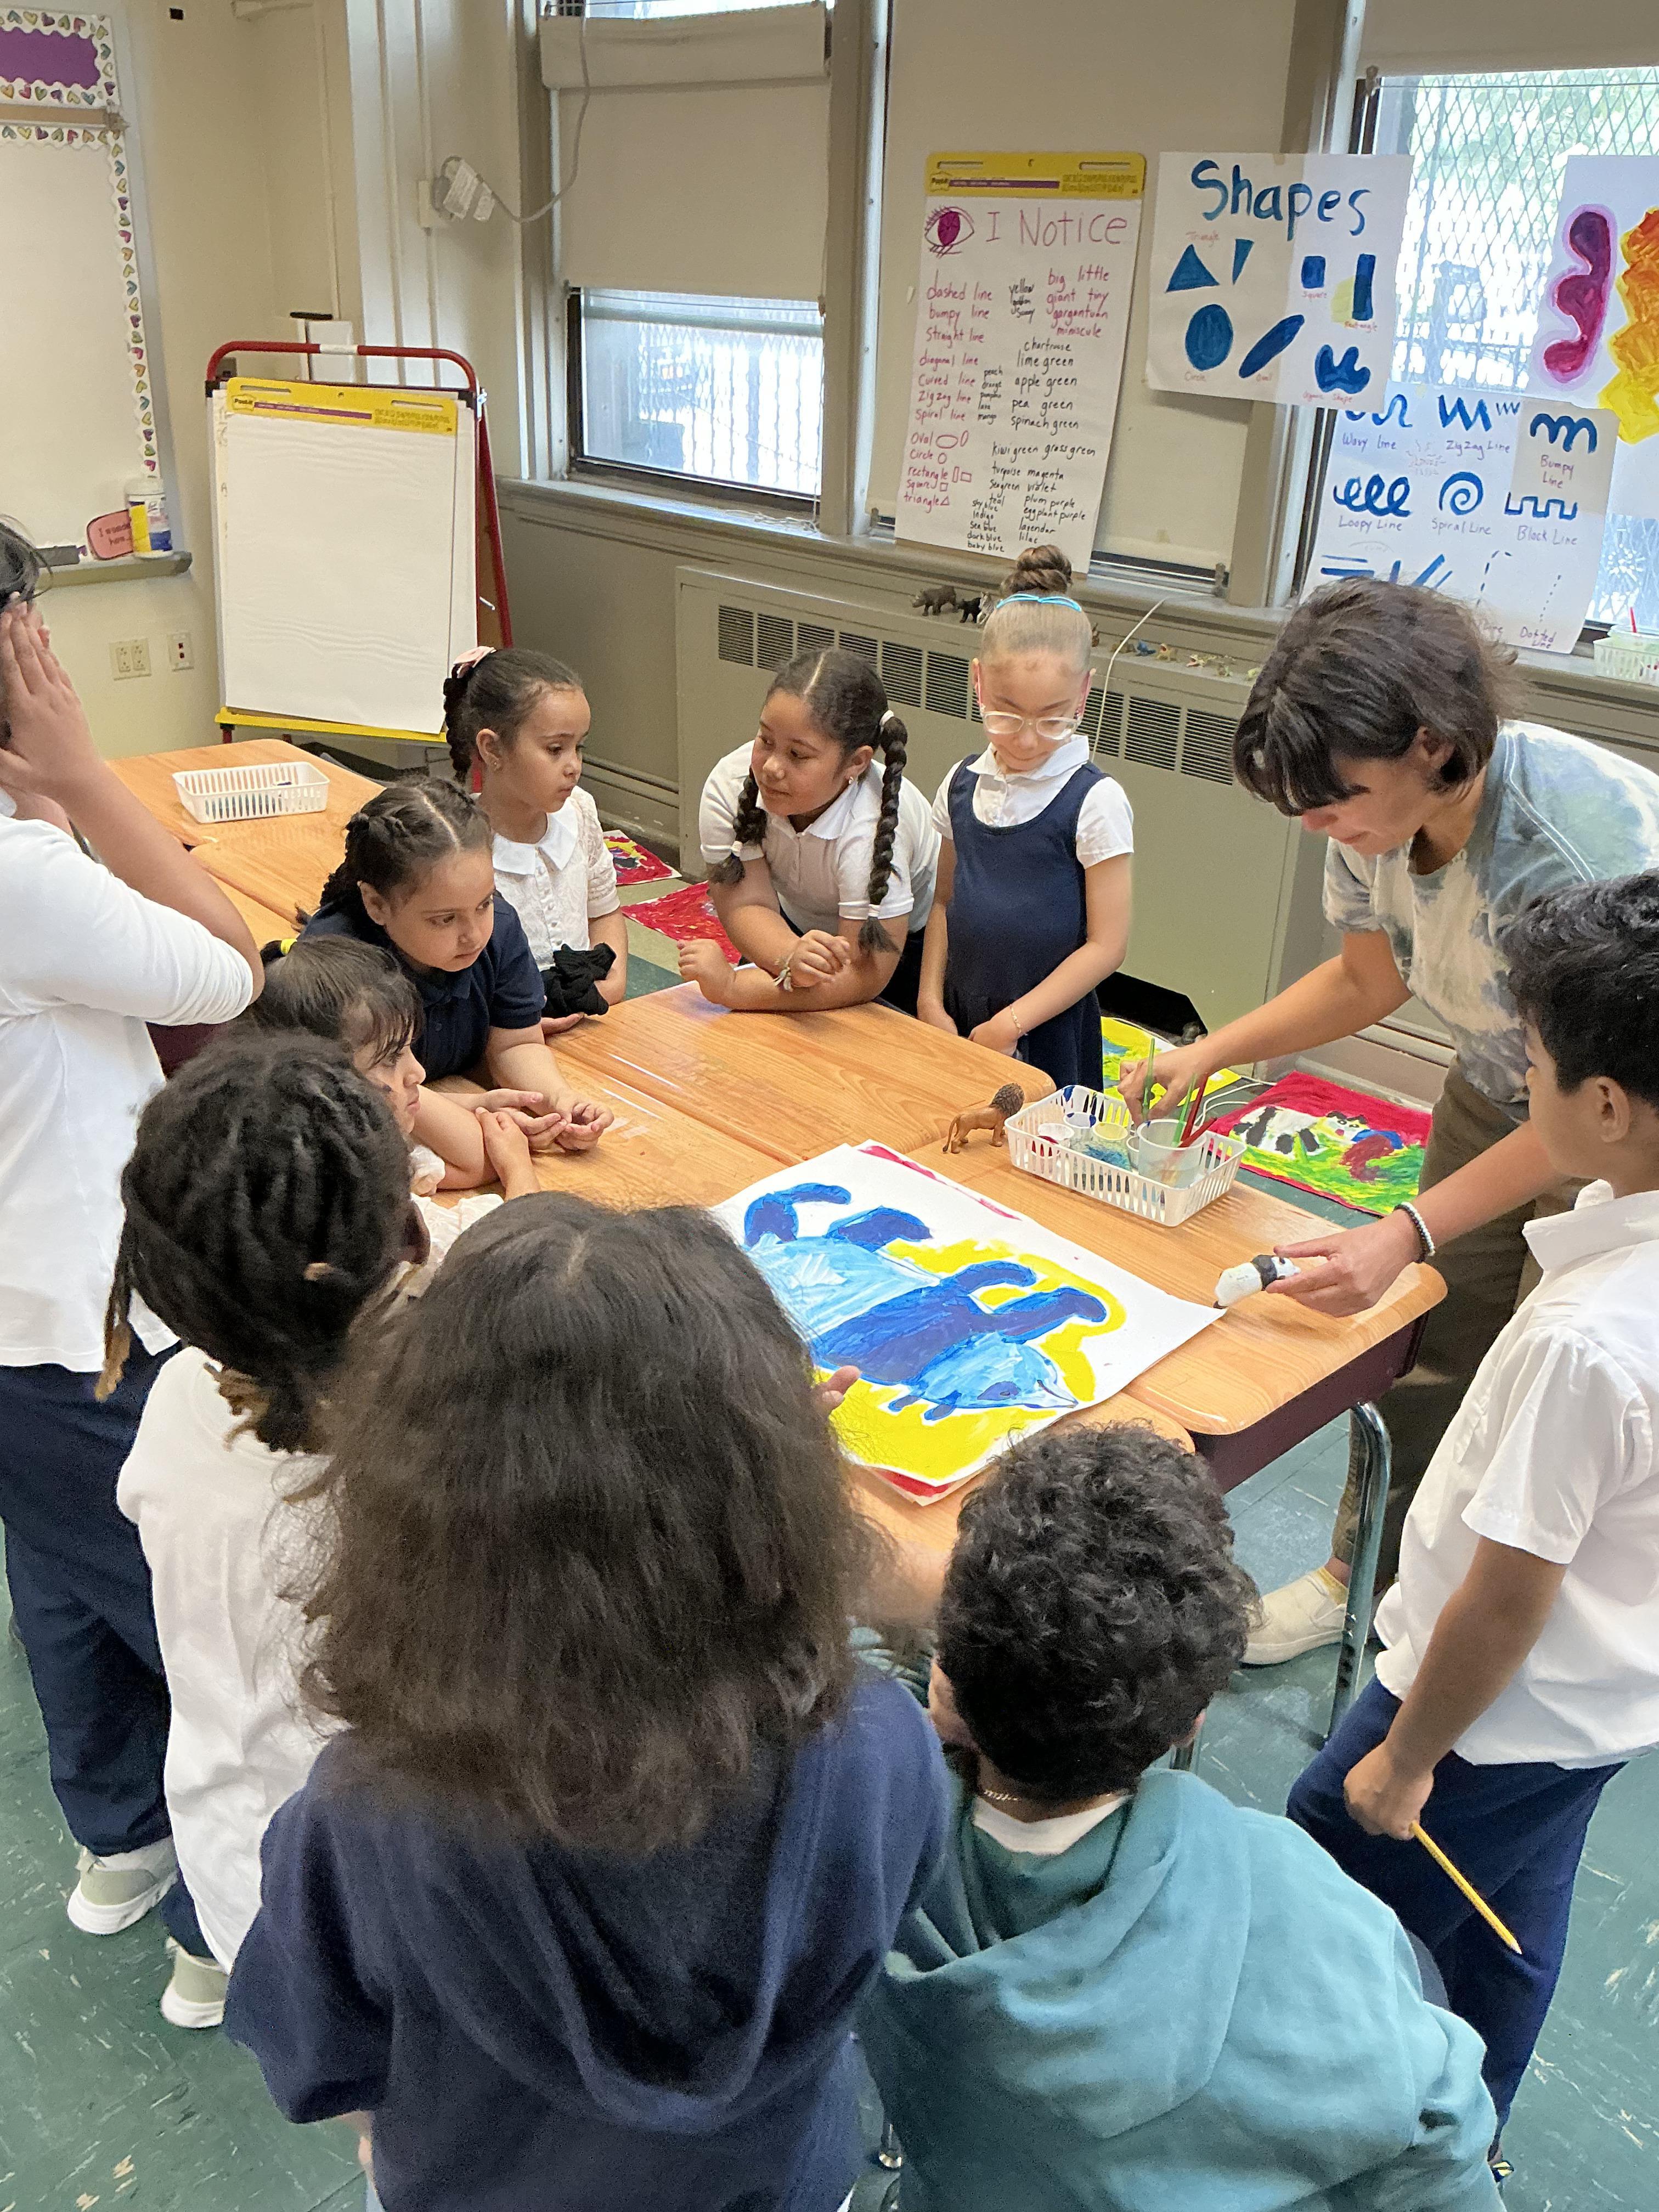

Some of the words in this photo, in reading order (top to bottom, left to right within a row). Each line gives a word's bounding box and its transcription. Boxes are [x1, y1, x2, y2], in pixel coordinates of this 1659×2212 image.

[1190, 159, 1371, 242] Shapes
[986, 211, 1000, 242] I
[1019, 207, 1127, 246] Notice
[1186, 230, 1221, 247] Triangle
[927, 269, 967, 300] dashed
[974, 281, 992, 300] line
[1048, 268, 1066, 292] big
[1078, 264, 1109, 281] little
[1009, 278, 1034, 303] yellow
[1046, 288, 1076, 314] giant
[1087, 287, 1109, 312] tiny
[929, 302, 960, 329] bumpy
[972, 304, 989, 319] line
[969, 328, 984, 343] line
[962, 353, 978, 366] line
[1017, 349, 1040, 367] lime
[1042, 357, 1074, 375] green
[958, 371, 975, 387] line
[1015, 374, 1040, 394] apple
[1044, 377, 1077, 397] green
[956, 390, 971, 404] line
[951, 408, 966, 421] line
[1012, 399, 1029, 413] pea
[1040, 401, 1073, 417] green
[1011, 415, 1049, 431] spinach
[1051, 420, 1079, 436] green
[991, 441, 1010, 457] kiwi
[1011, 445, 1038, 463] green
[1042, 444, 1068, 461] grass
[1066, 445, 1096, 460] green
[1487, 441, 1510, 453] Line
[1540, 454, 1575, 480] Bumpy
[908, 465, 949, 489] rectangle
[1027, 468, 1064, 484] magenta
[1542, 471, 1563, 488] Line
[1027, 482, 1057, 492] violet
[904, 492, 939, 514] triangle
[972, 499, 983, 509] sky
[984, 501, 998, 512] blue
[989, 493, 1006, 506] teal
[1024, 494, 1047, 506] plum
[1050, 498, 1075, 511] purple
[969, 521, 980, 529] sea
[983, 520, 997, 532] blue
[1059, 511, 1086, 525] purple
[1339, 515, 1372, 534] Loopy
[1377, 520, 1403, 532] Line
[1431, 517, 1466, 535] Spiral
[1469, 522, 1492, 535] Line
[967, 530, 984, 540] dark
[986, 533, 1002, 543] blue
[1019, 532, 1038, 544] lilac
[1517, 525, 1548, 542] Block
[1553, 529, 1578, 546] Line
[967, 540, 985, 551] baby
[988, 543, 1005, 552] blue
[1520, 626, 1557, 642] Dotted
